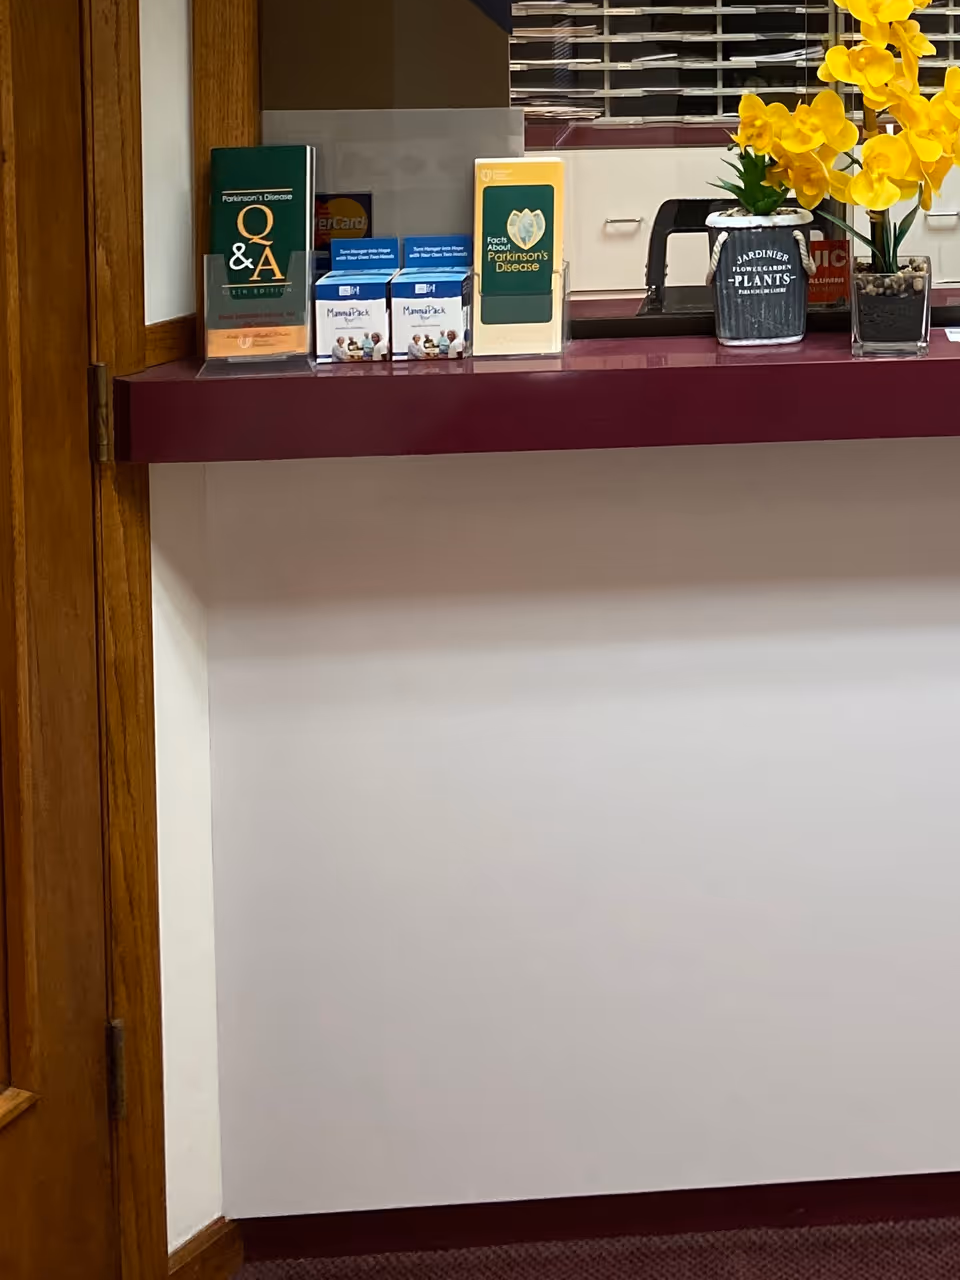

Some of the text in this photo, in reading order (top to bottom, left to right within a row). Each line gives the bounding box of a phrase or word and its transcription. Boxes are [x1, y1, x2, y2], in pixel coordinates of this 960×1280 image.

[222, 192, 293, 202] Parkinson's Disease
[236, 204, 274, 245] Q
[318, 216, 366, 230] erCard
[487, 236, 508, 244] Facts
[229, 242, 285, 281] & A
[488, 250, 548, 262] Parkinson's
[736, 249, 790, 264] JARDINIER
[496, 262, 540, 272] Disease
[763, 264, 792, 272] GARDEN
